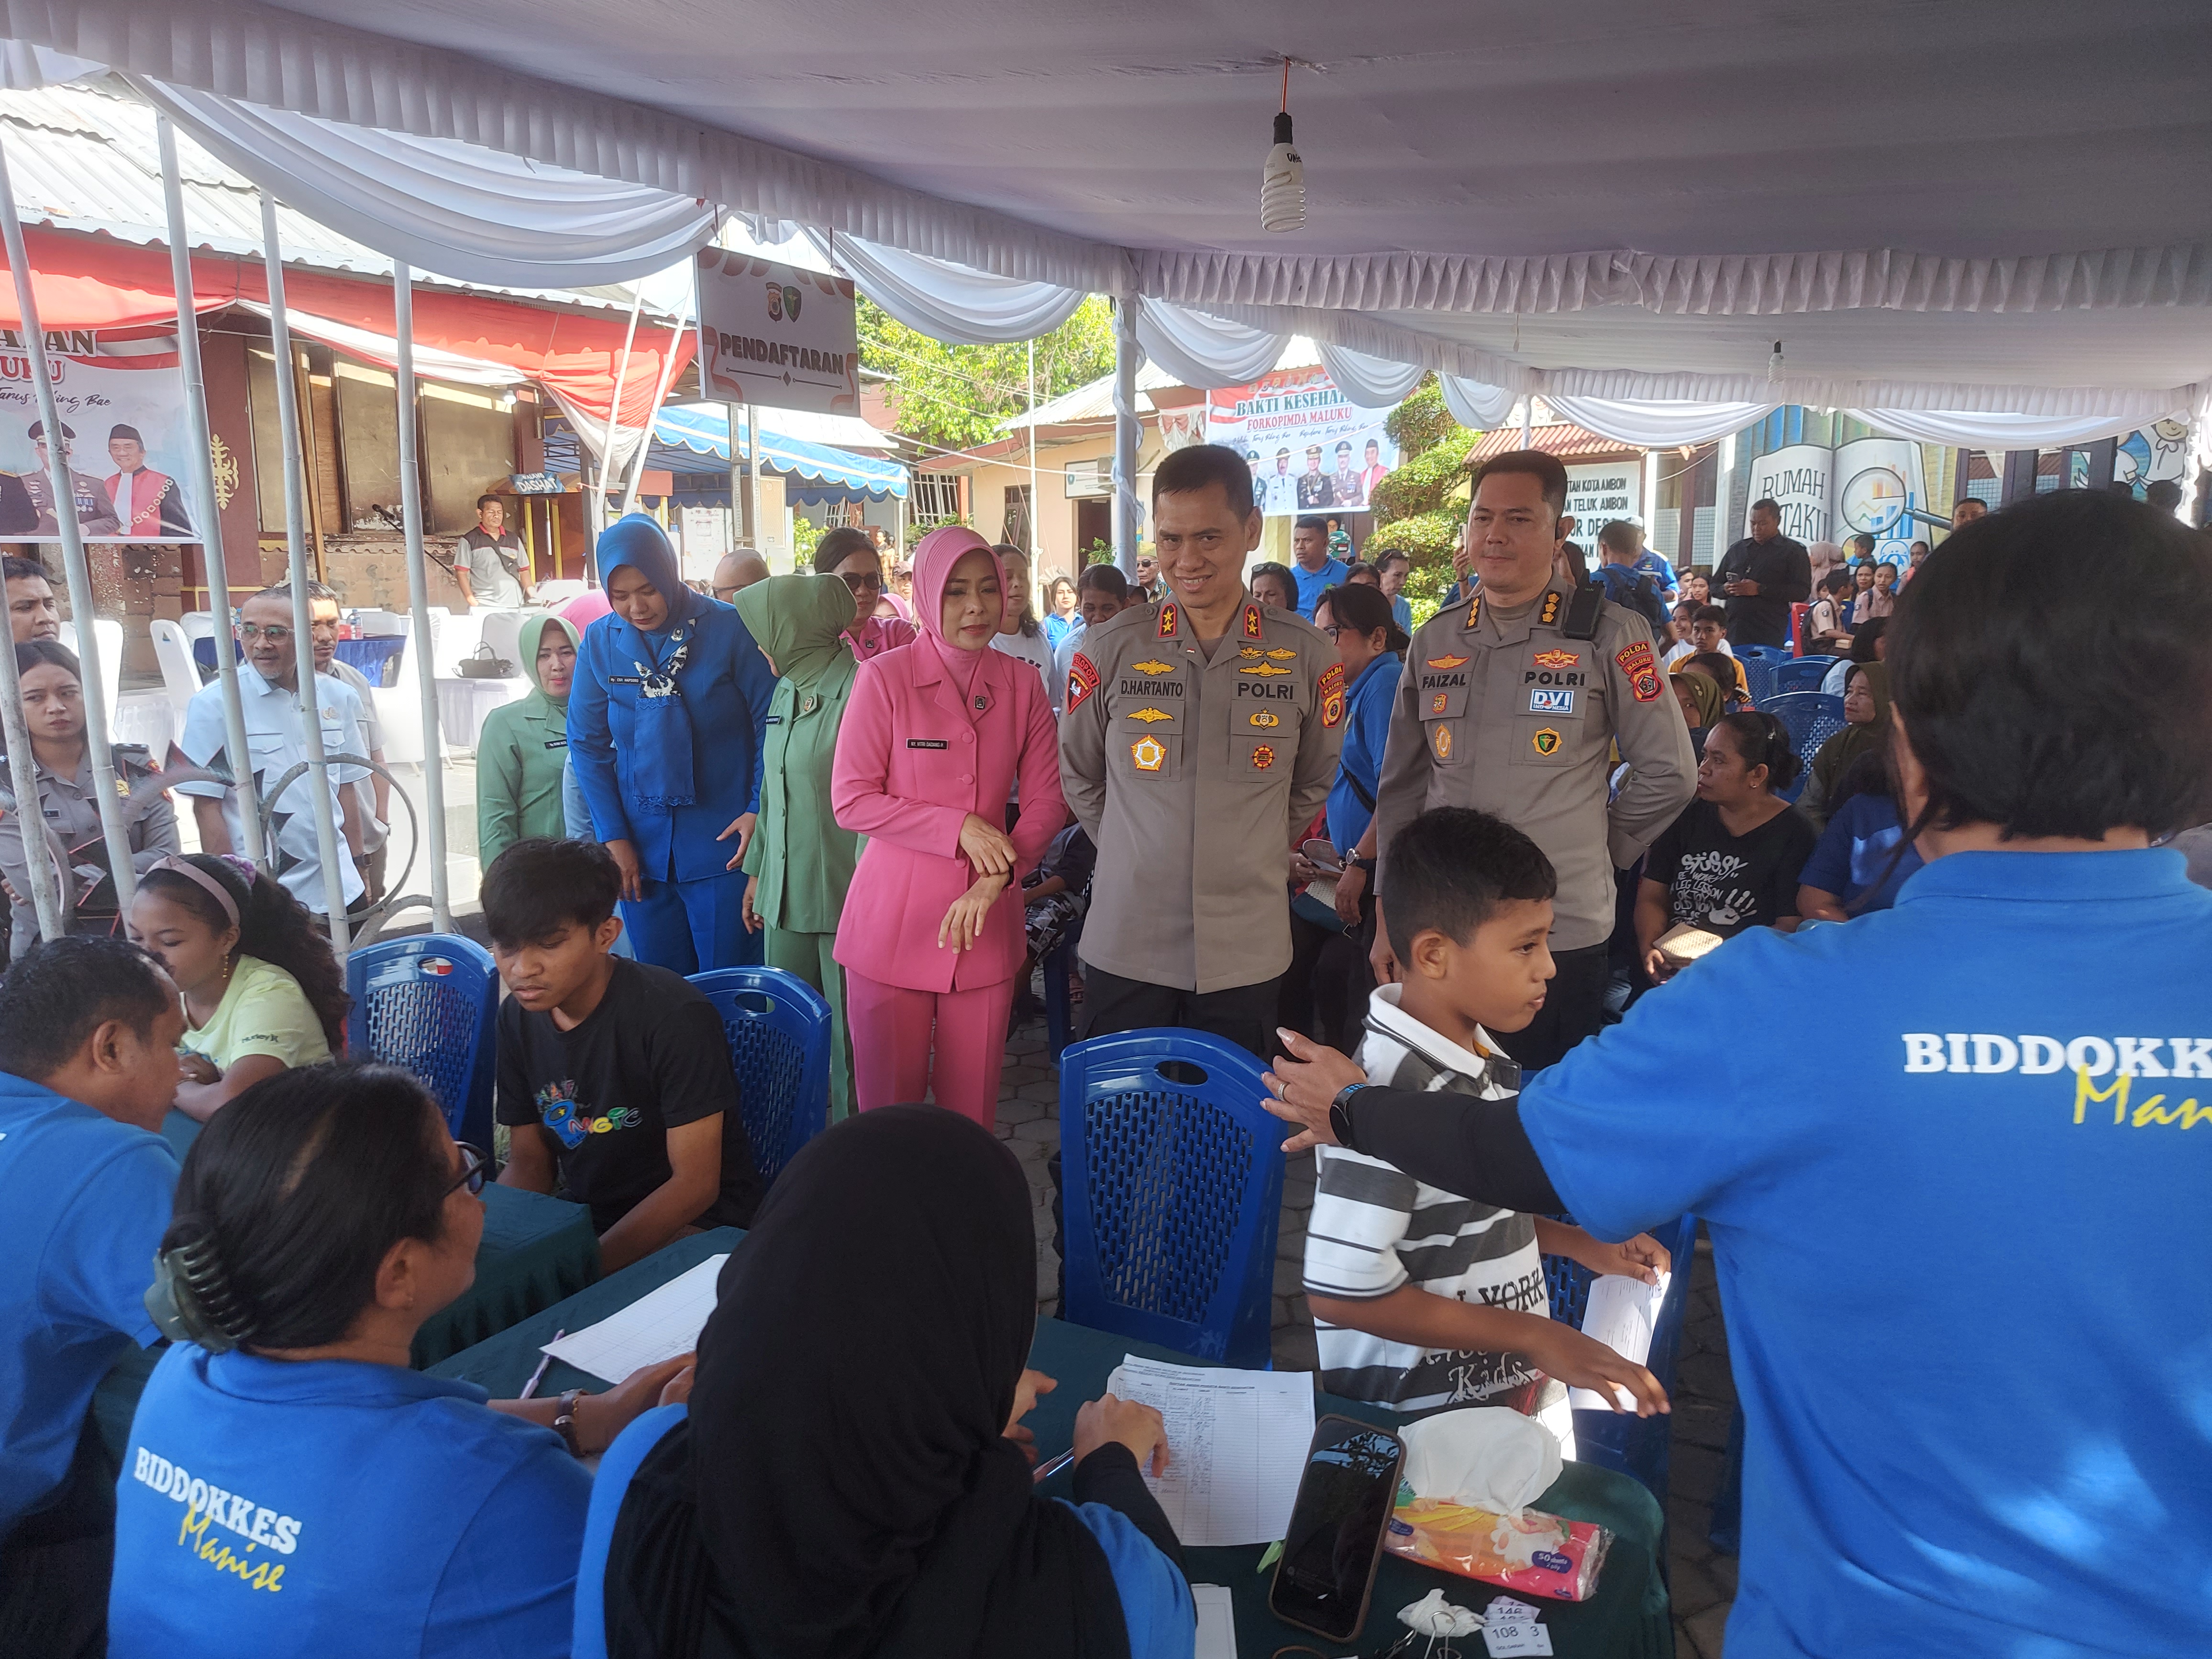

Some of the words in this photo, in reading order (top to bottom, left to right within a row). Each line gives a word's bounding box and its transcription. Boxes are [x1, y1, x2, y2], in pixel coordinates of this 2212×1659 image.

[719, 332, 844, 375] PENDAFTARAN
[85, 395, 111, 406] Bae
[1236, 398, 1280, 416] BAKTI
[1247, 414, 1307, 431] FORKOPIMDA
[1310, 407, 1352, 423] MALUKU
[517, 478, 558, 492] DASHAT
[1567, 480, 1581, 492] TAH
[1582, 479, 1600, 492] KOTA
[1601, 478, 1626, 491] AMBON
[1762, 469, 1825, 500] RUMAH
[1574, 498, 1598, 512] TELUK
[1600, 497, 1628, 510] AMBON
[1780, 502, 1827, 542] TAKU
[1619, 644, 1647, 663] POLDA
[1626, 657, 1651, 671] MALUKU
[1322, 666, 1342, 685] POLDA
[1422, 674, 1466, 689] FAIZAL
[1525, 671, 1585, 686] POLRI
[1121, 680, 1183, 697] D.HARTANTO
[1238, 682, 1294, 700] POLRI
[1324, 681, 1342, 695] MALUKU
[1534, 691, 1570, 706] DVI
[1692, 880, 1724, 900] LESSON
[1674, 900, 1692, 910] OLD
[1478, 1267, 1544, 1311] YORK
[1447, 1352, 1531, 1405] Kids
[134, 1446, 302, 1554] BIDDOKKES
[178, 1501, 286, 1592] Manise
[1493, 1626, 1519, 1638] 108
[1530, 1626, 1539, 1637] 3
